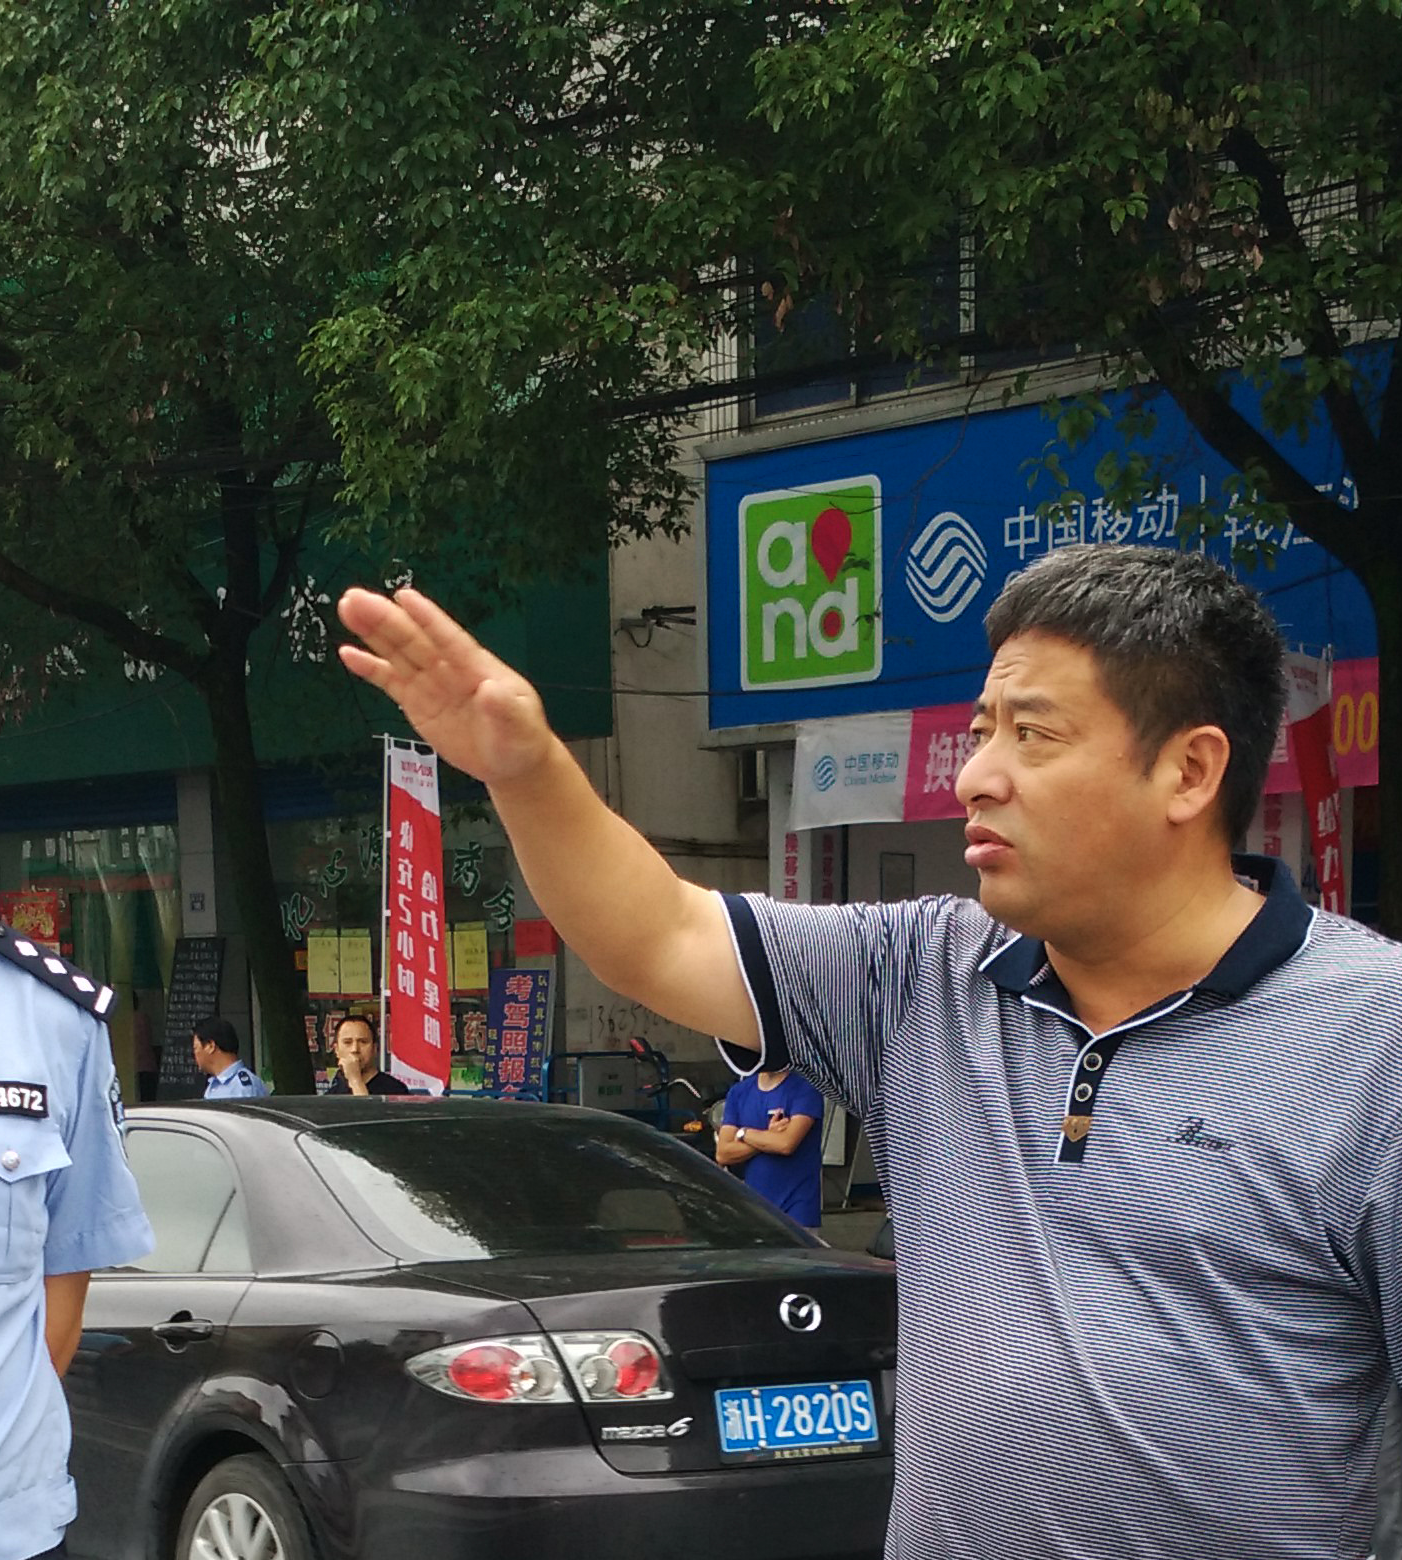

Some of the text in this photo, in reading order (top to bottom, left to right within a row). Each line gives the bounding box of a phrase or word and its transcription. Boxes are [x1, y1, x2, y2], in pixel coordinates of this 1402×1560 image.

[1002, 482, 1179, 560] 中国移动
[844, 751, 900, 772] 中国移动
